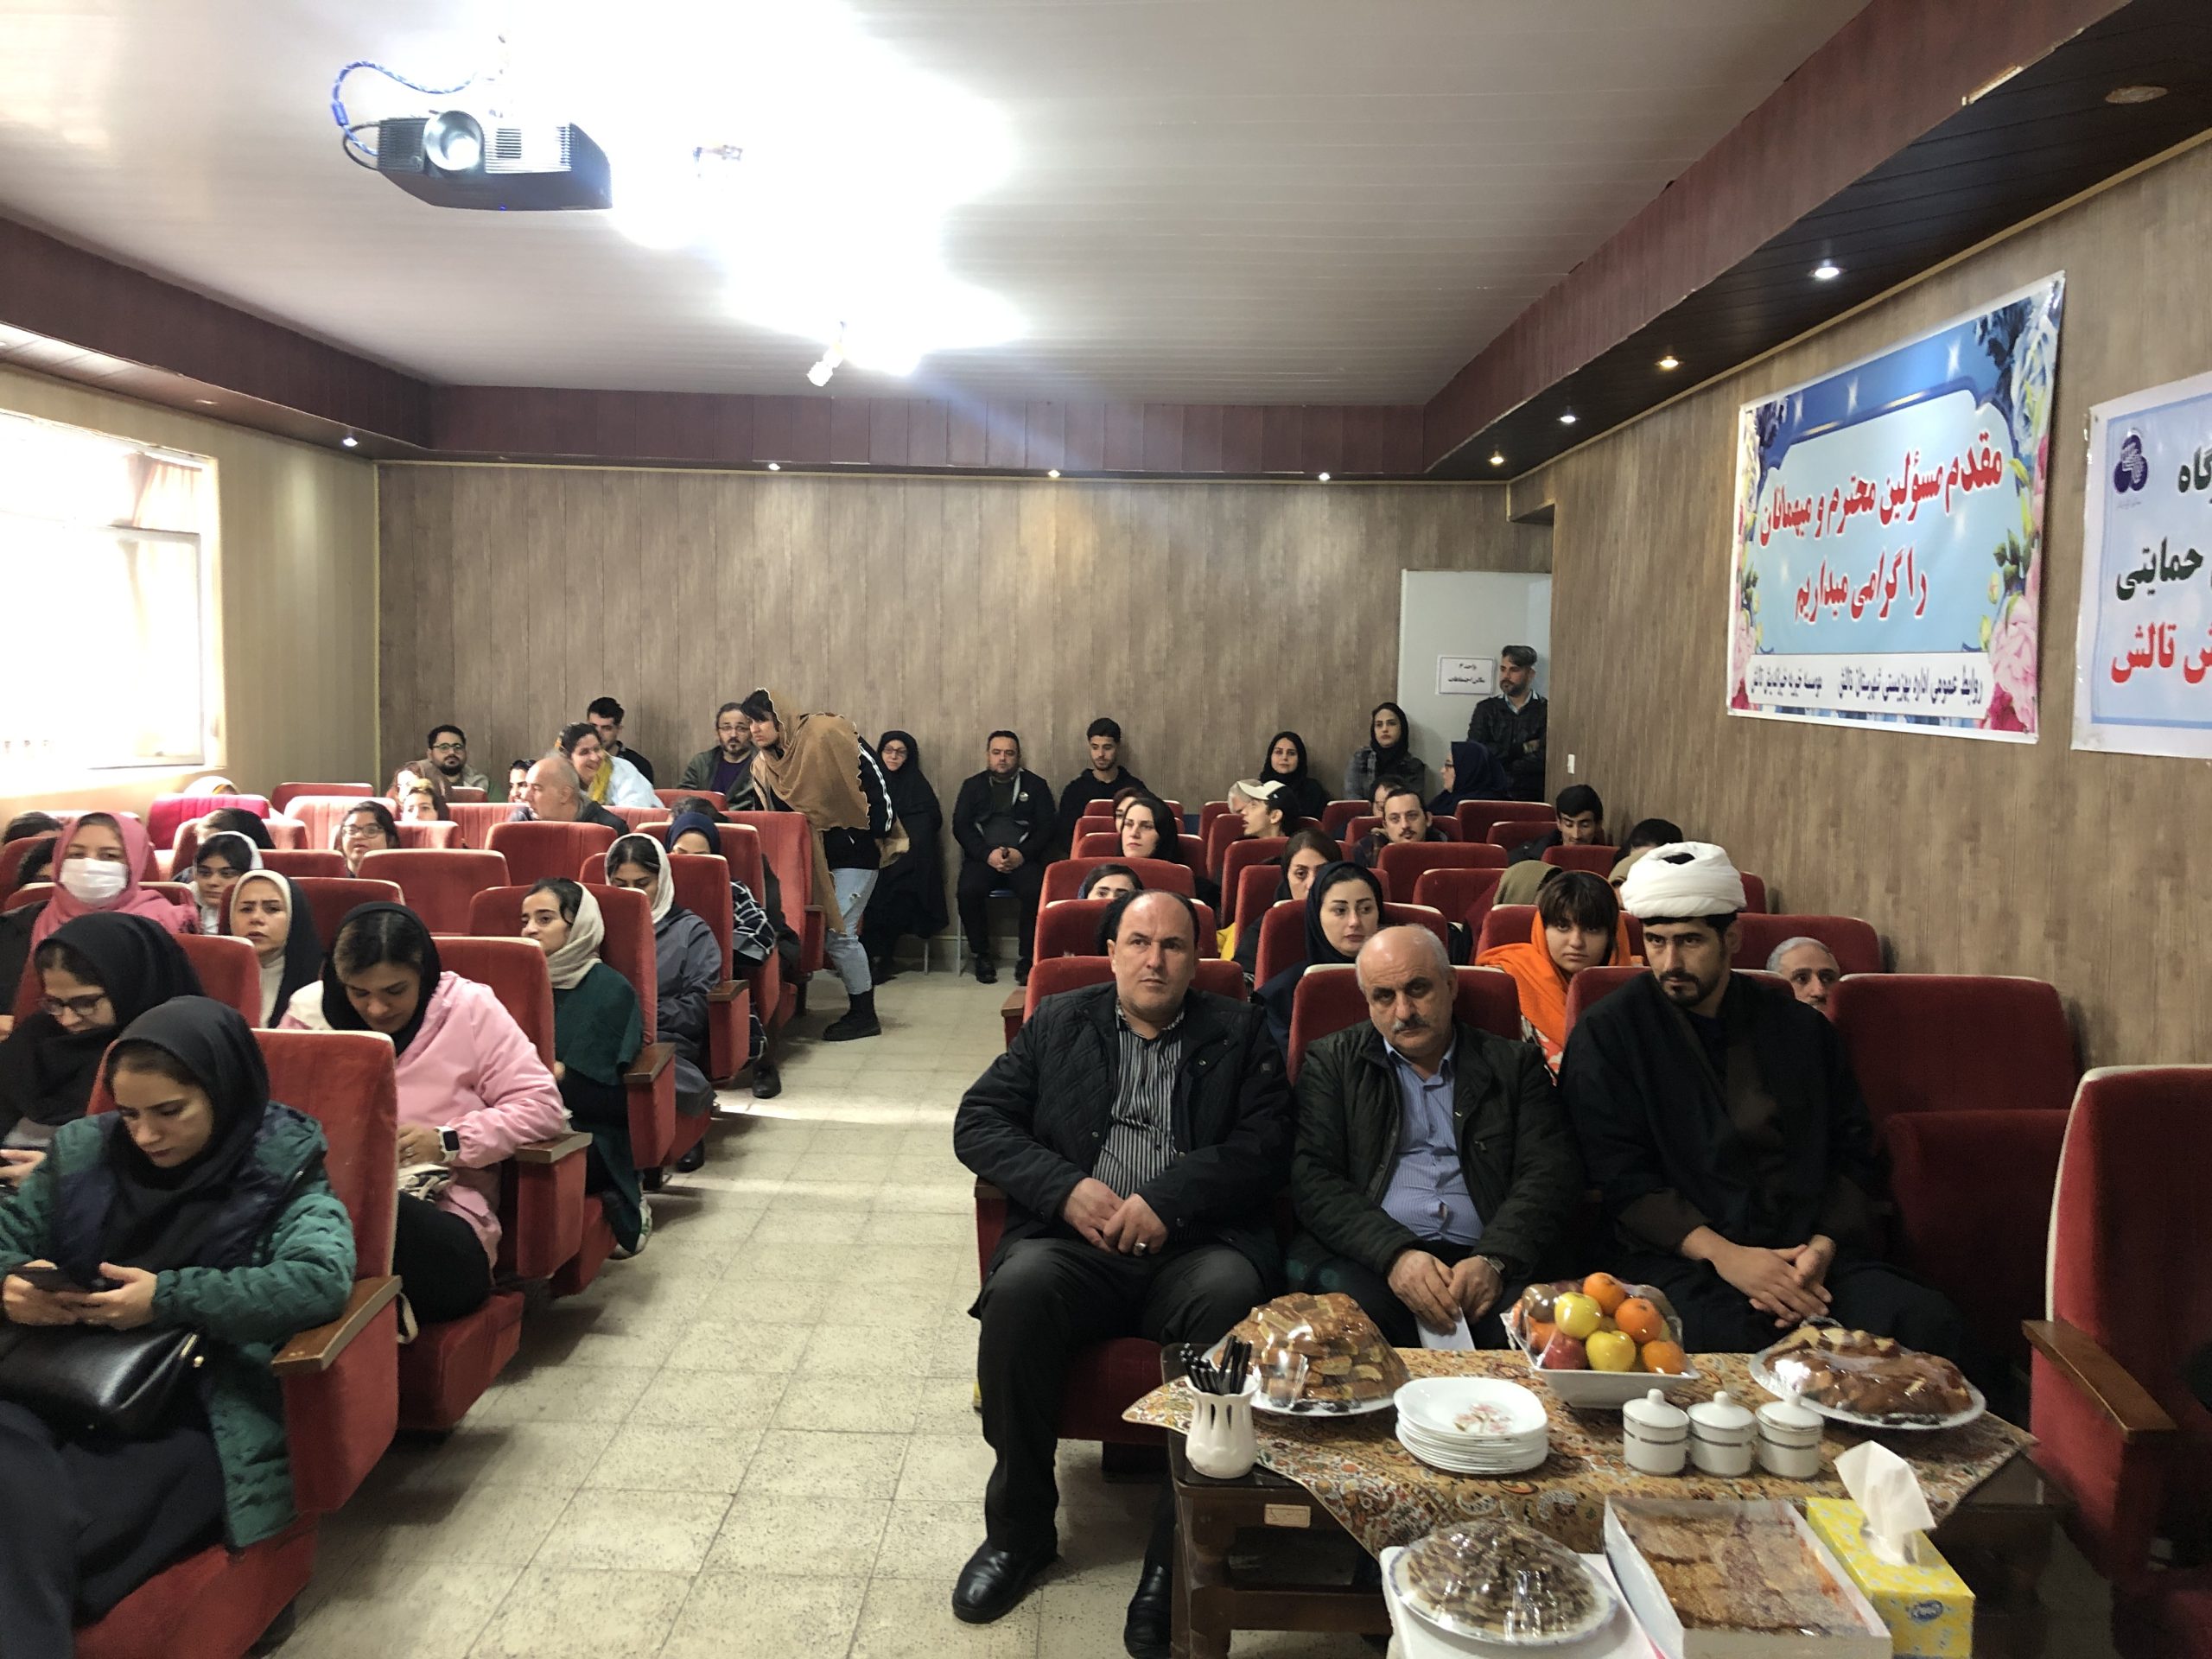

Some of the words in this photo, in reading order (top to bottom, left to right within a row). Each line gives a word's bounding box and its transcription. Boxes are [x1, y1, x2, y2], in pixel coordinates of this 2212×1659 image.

[1946, 432, 2003, 513] مقدم
[1760, 485, 1813, 547] میهمانان
[1815, 496, 1825, 538] و
[1827, 476, 1877, 535] محترم
[1851, 548, 1904, 620] گرامی
[1907, 546, 1928, 616] را
[2116, 535, 2203, 601] حمایتی
[2111, 621, 2177, 683] تالش
[1930, 675, 1957, 704] عمومی
[1961, 664, 1984, 705] روابط
